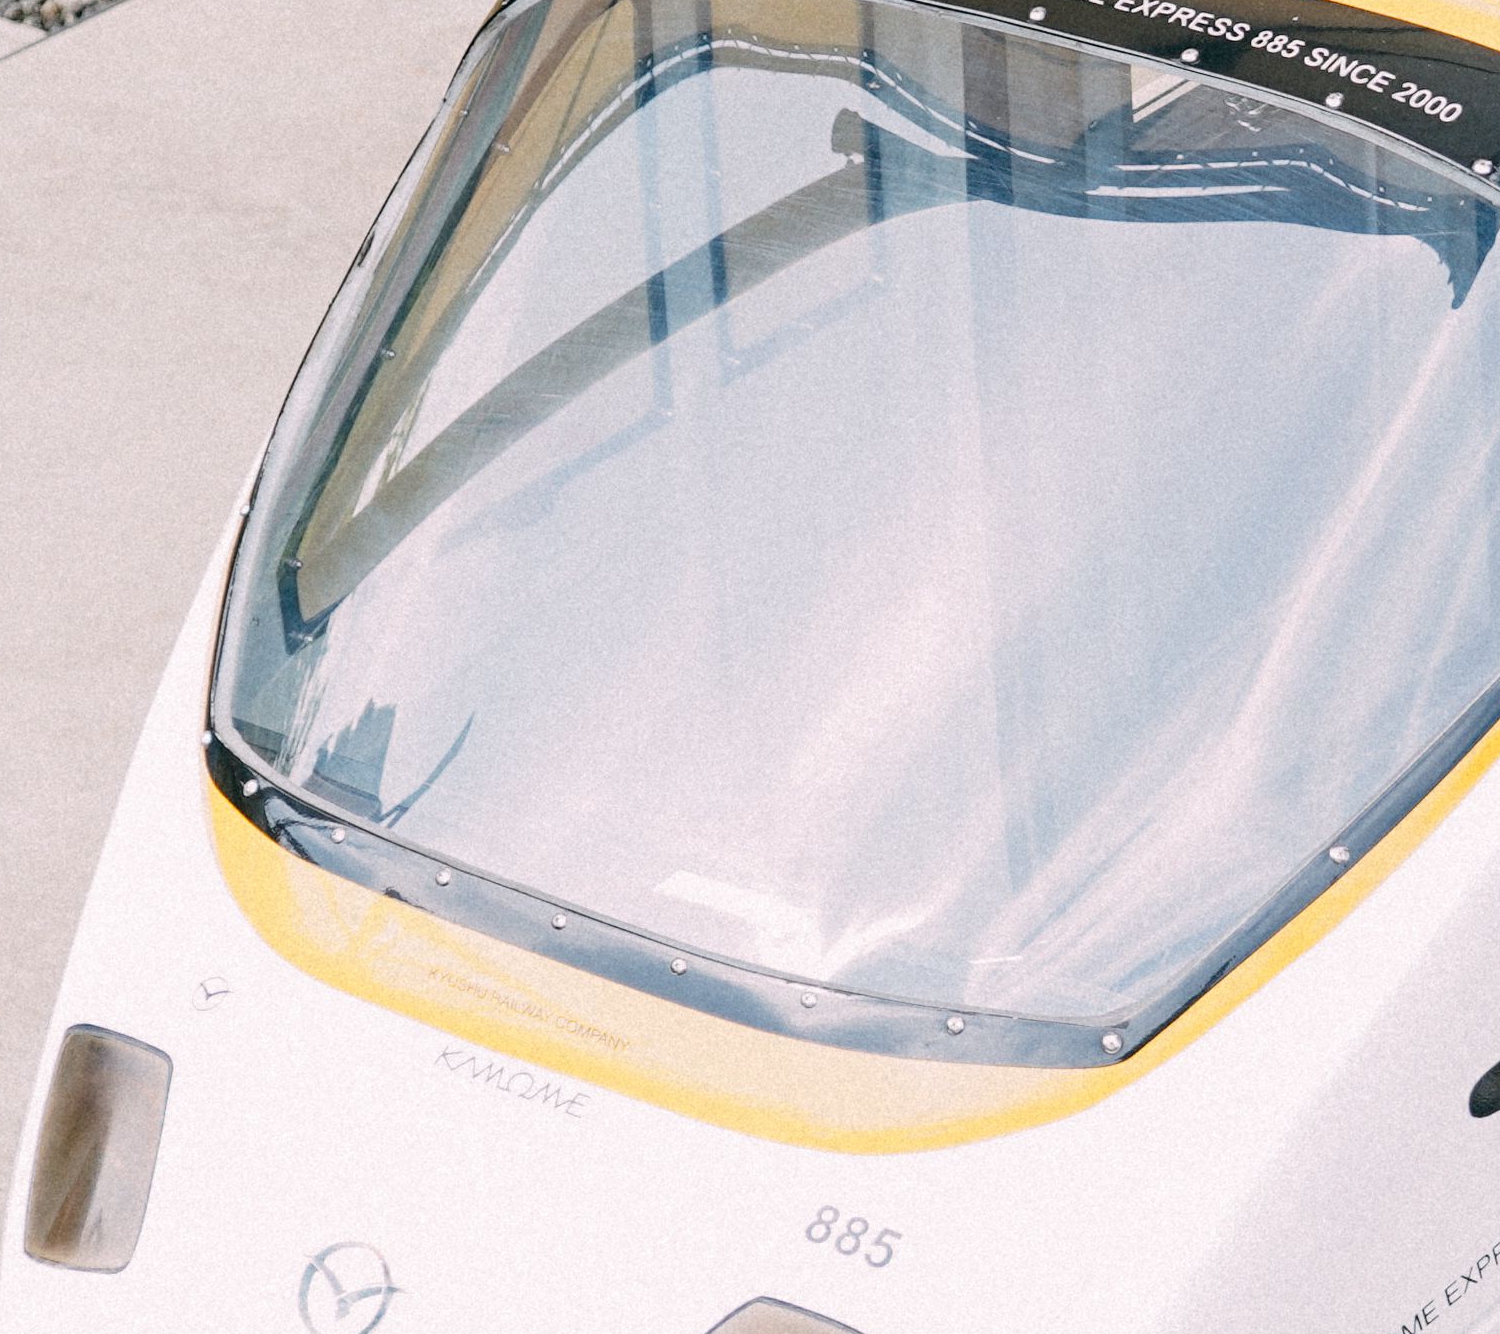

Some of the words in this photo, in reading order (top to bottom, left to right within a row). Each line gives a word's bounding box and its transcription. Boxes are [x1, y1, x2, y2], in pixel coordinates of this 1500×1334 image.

[1250, 29, 1305, 60] 885
[1304, 46, 1396, 93] SINCE
[1392, 82, 1464, 123] 2000
[429, 967, 488, 999] KYUSHU
[491, 991, 555, 1022] RAILWAY
[555, 1015, 631, 1052] COMPANY
[434, 1045, 591, 1119] KAMOME
[805, 1205, 903, 1268] 885
